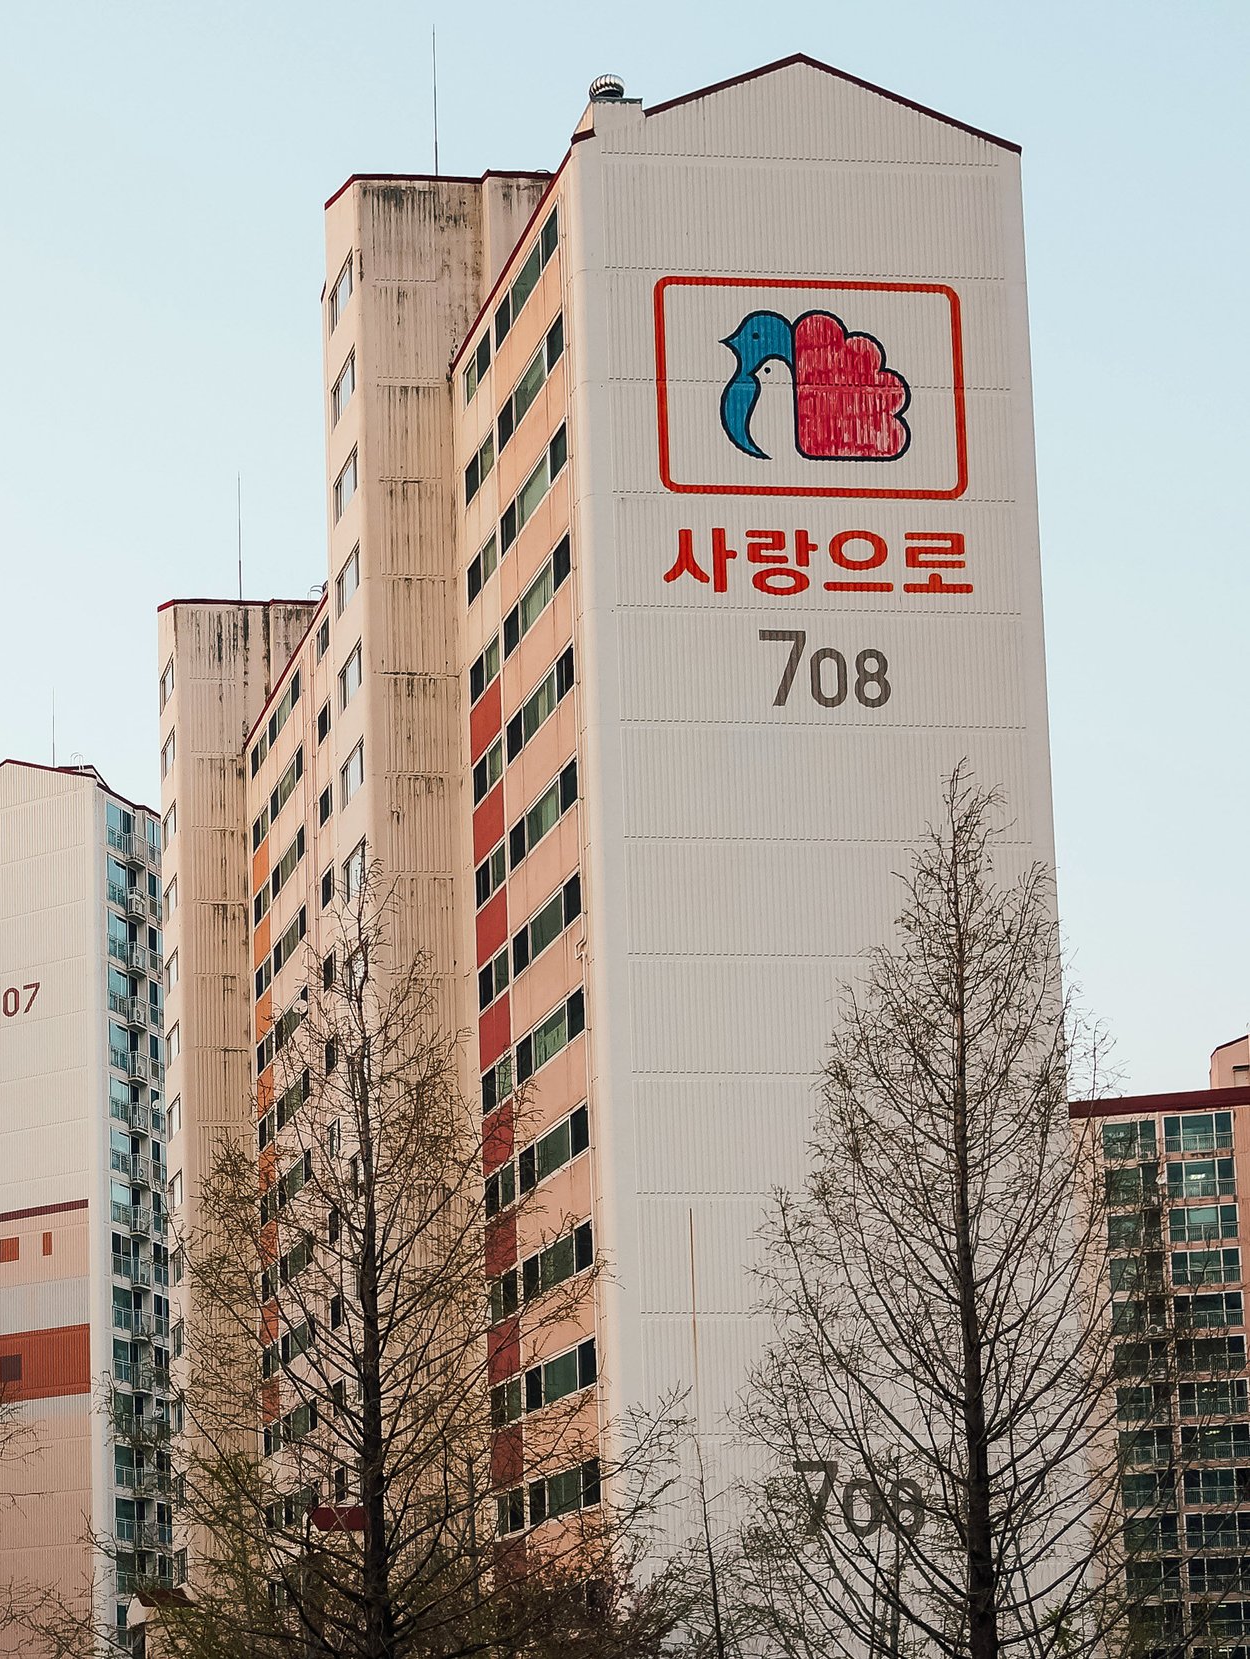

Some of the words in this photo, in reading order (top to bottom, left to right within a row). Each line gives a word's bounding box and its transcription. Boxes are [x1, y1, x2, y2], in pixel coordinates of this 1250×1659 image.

[663, 528, 974, 596] 사랑으로
[759, 629, 892, 708] 708
[792, 1461, 925, 1538] 708
